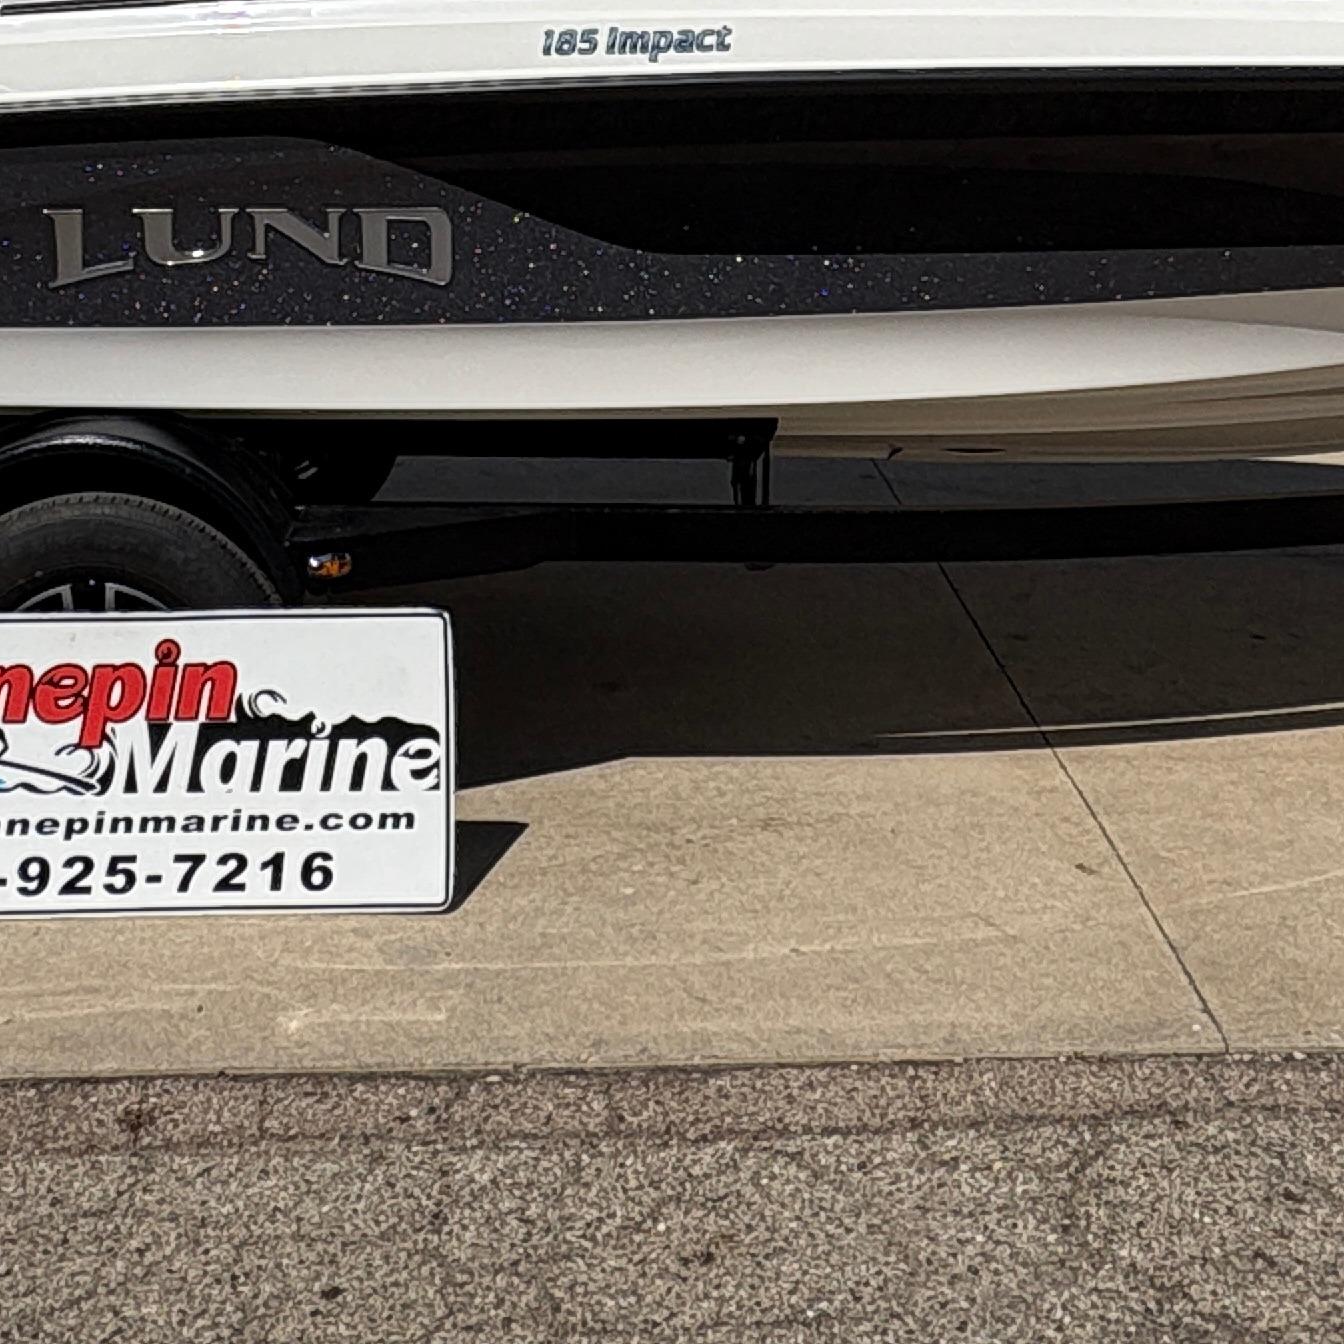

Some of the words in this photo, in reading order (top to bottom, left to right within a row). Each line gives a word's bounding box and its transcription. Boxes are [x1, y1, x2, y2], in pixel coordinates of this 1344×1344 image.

[542, 28, 599, 56] 185
[606, 24, 733, 64] Impact
[42, 207, 454, 288] LUND
[112, 716, 442, 794] Marine
